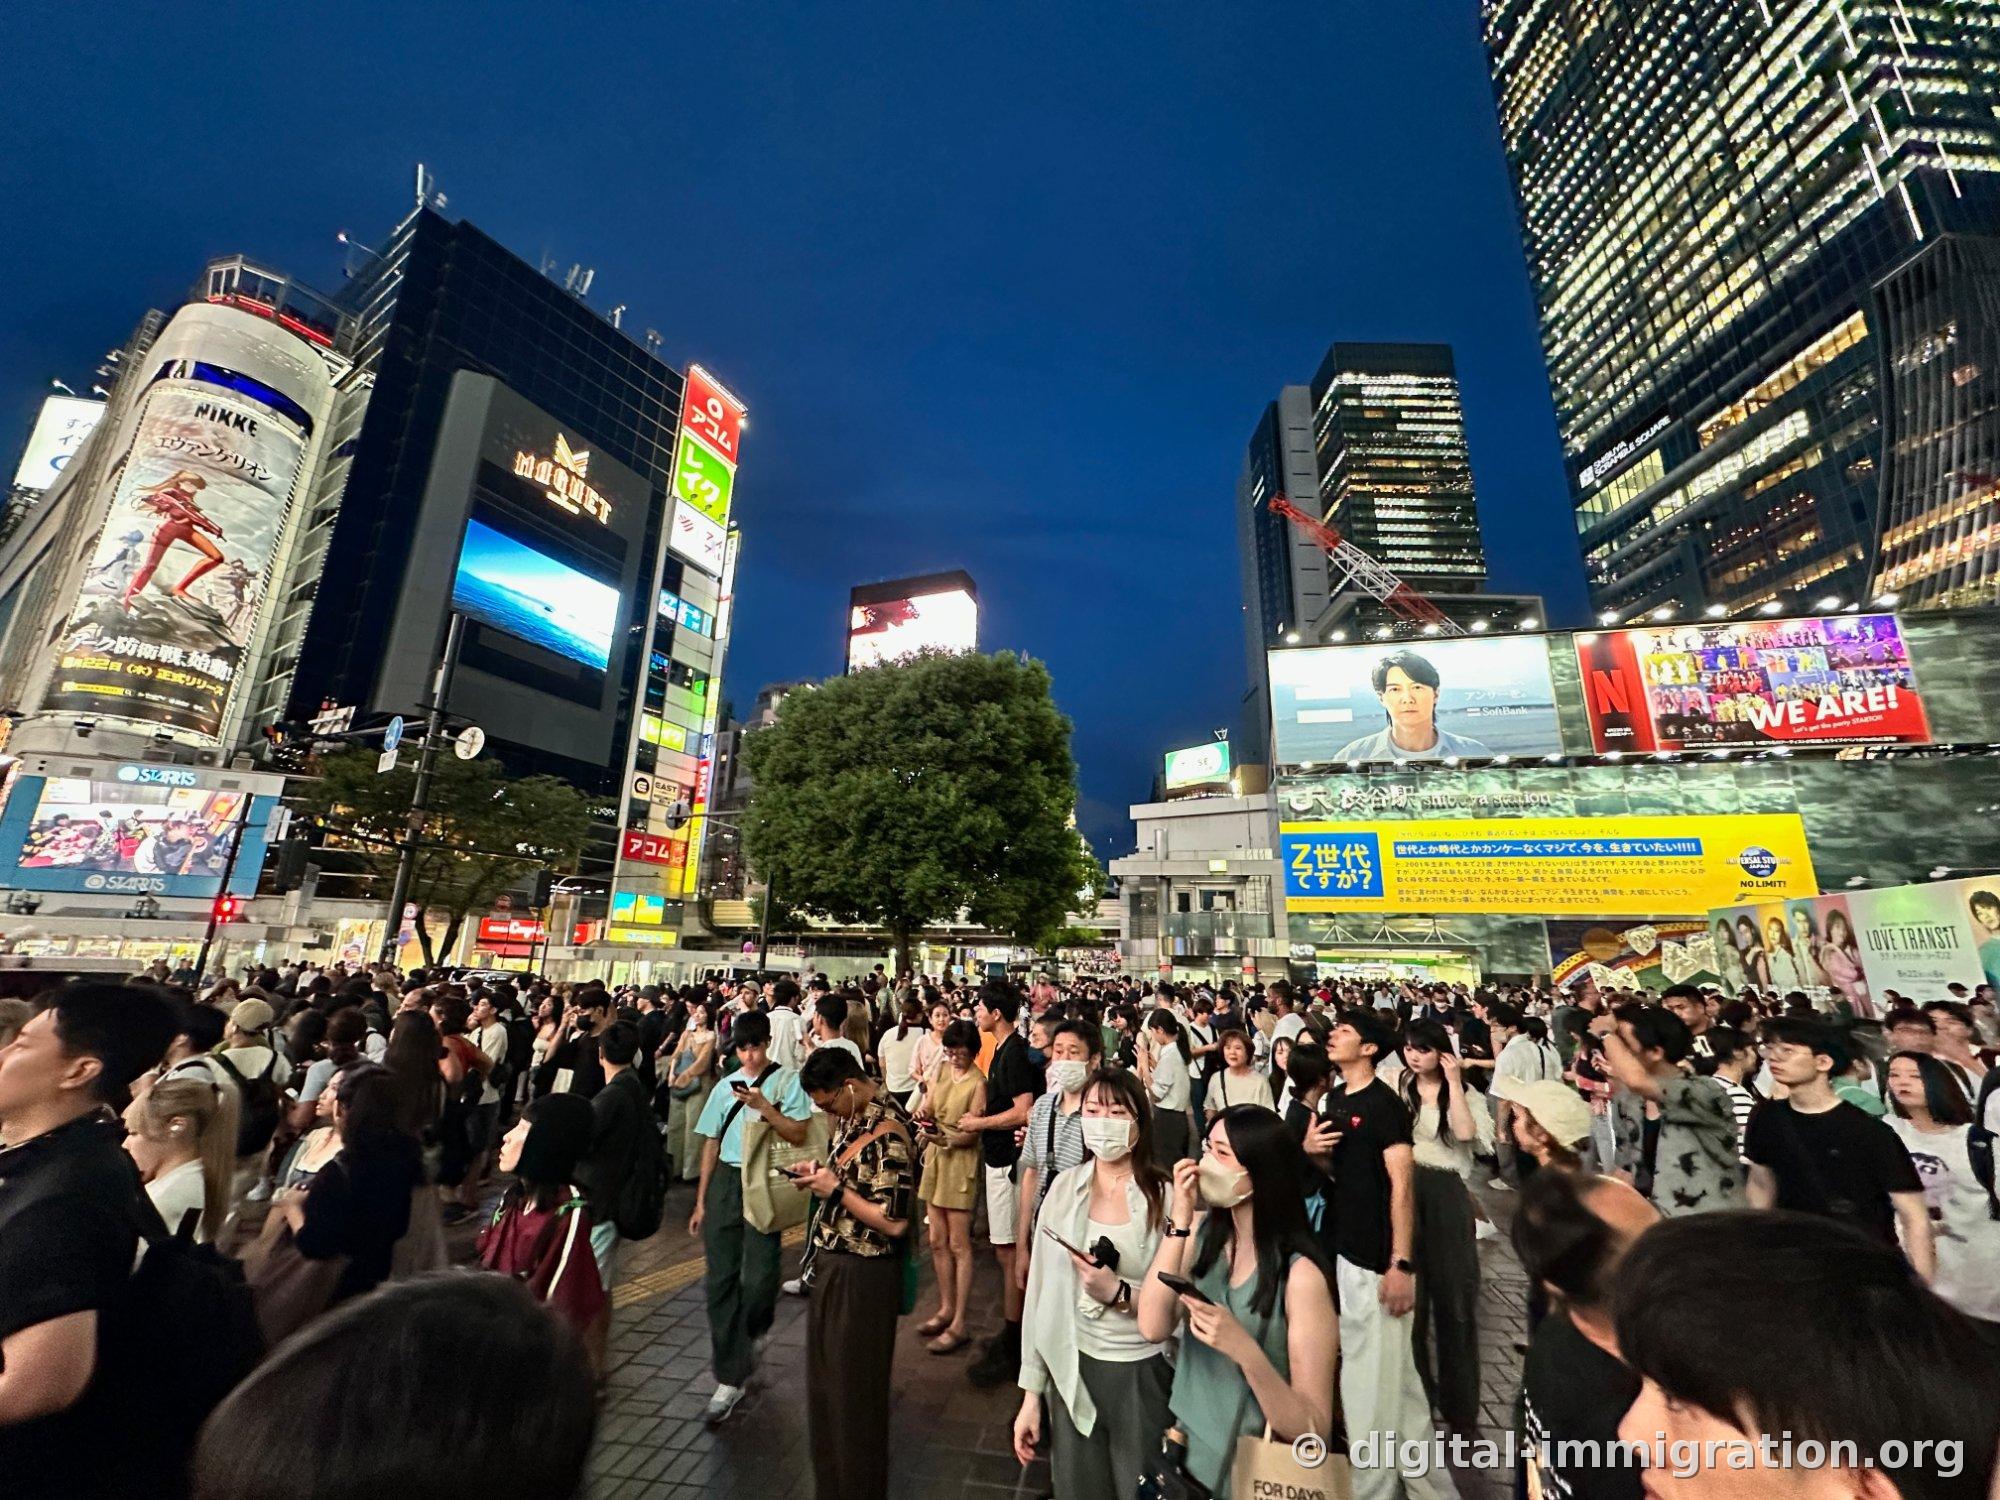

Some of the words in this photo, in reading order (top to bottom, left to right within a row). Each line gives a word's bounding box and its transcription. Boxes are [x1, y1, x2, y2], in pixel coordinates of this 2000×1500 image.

[194, 402, 260, 438] NIKKE
[691, 404, 732, 453] アコム
[155, 435, 273, 481] エヴァンゲリオン
[681, 442, 721, 505] レイク
[514, 450, 613, 526] MAGNET
[1592, 669, 1630, 715] N
[1482, 705, 1529, 717] SoftBank
[1746, 698, 1806, 731] WE
[1815, 683, 1899, 721] ARE!
[139, 768, 197, 786] STARTS
[655, 781, 677, 793] EAST
[1289, 788, 1335, 814] JR
[1339, 784, 1420, 812] 渋谷駅
[1492, 789, 1551, 808] station
[629, 837, 670, 859] アコム
[1290, 843, 1372, 870] Z世代
[106, 876, 165, 892] STARTS
[1291, 869, 1372, 890] ですが?
[1740, 880, 1754, 888] NO
[1755, 880, 1787, 888] LIMIT!
[1865, 928, 1898, 952] LOVE
[1253, 1479, 1283, 1499] FOR
